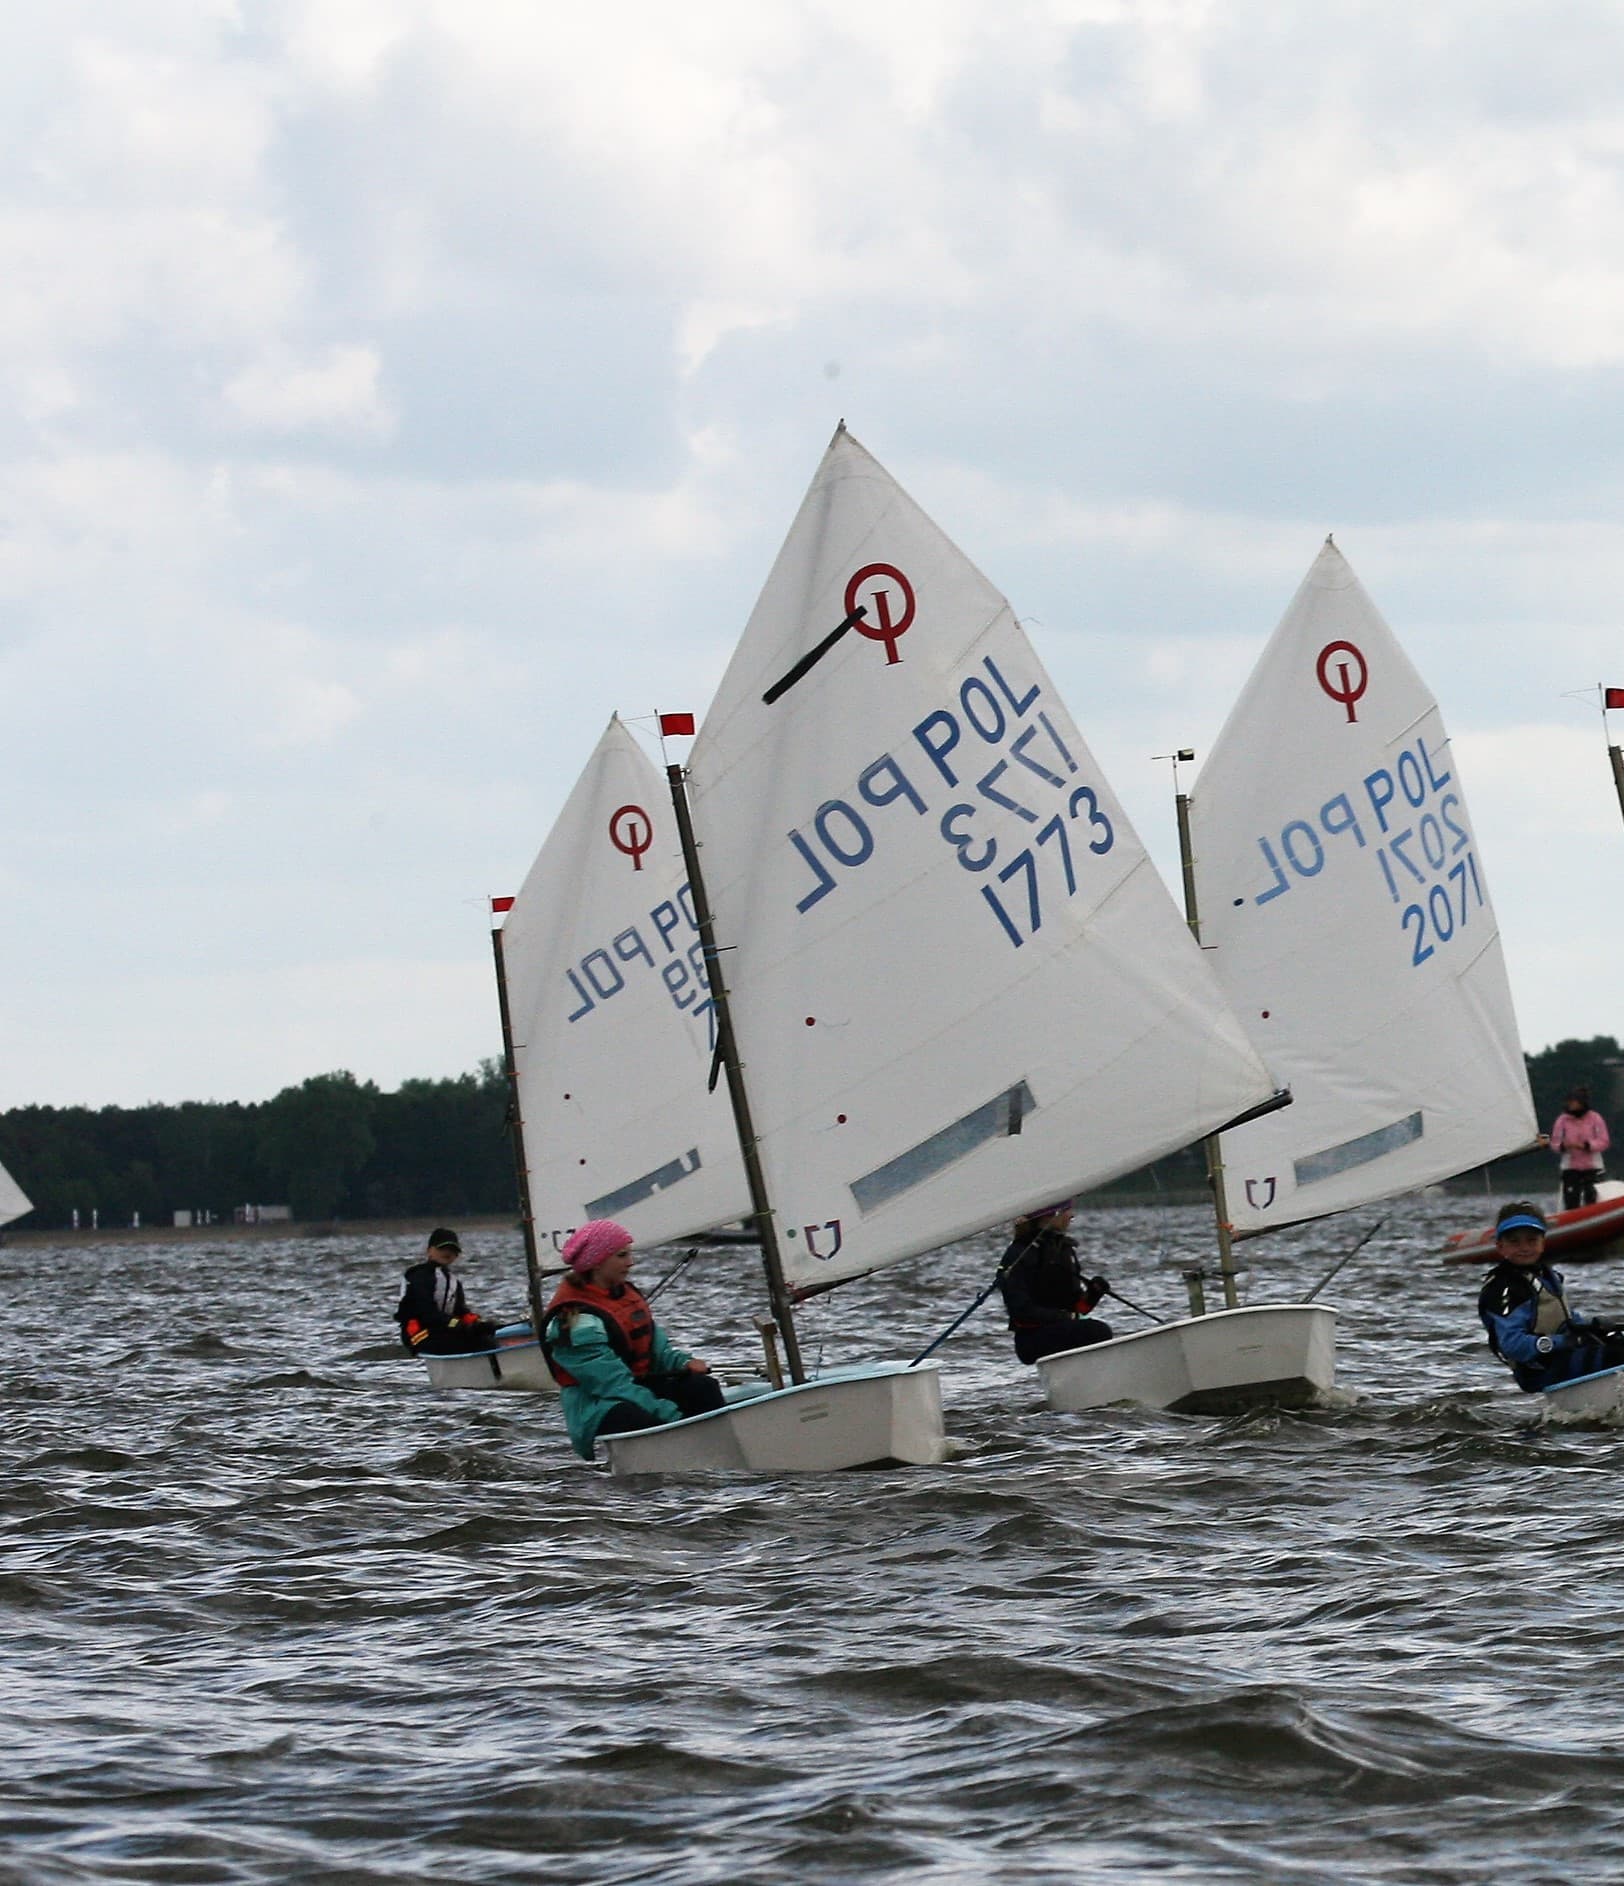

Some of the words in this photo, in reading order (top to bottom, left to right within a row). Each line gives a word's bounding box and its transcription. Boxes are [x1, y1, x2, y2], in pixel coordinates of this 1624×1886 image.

[912, 656, 1041, 788] POL
[1363, 738, 1450, 833] POL
[980, 786, 1114, 948] 1773
[1402, 852, 1483, 967] 2071
